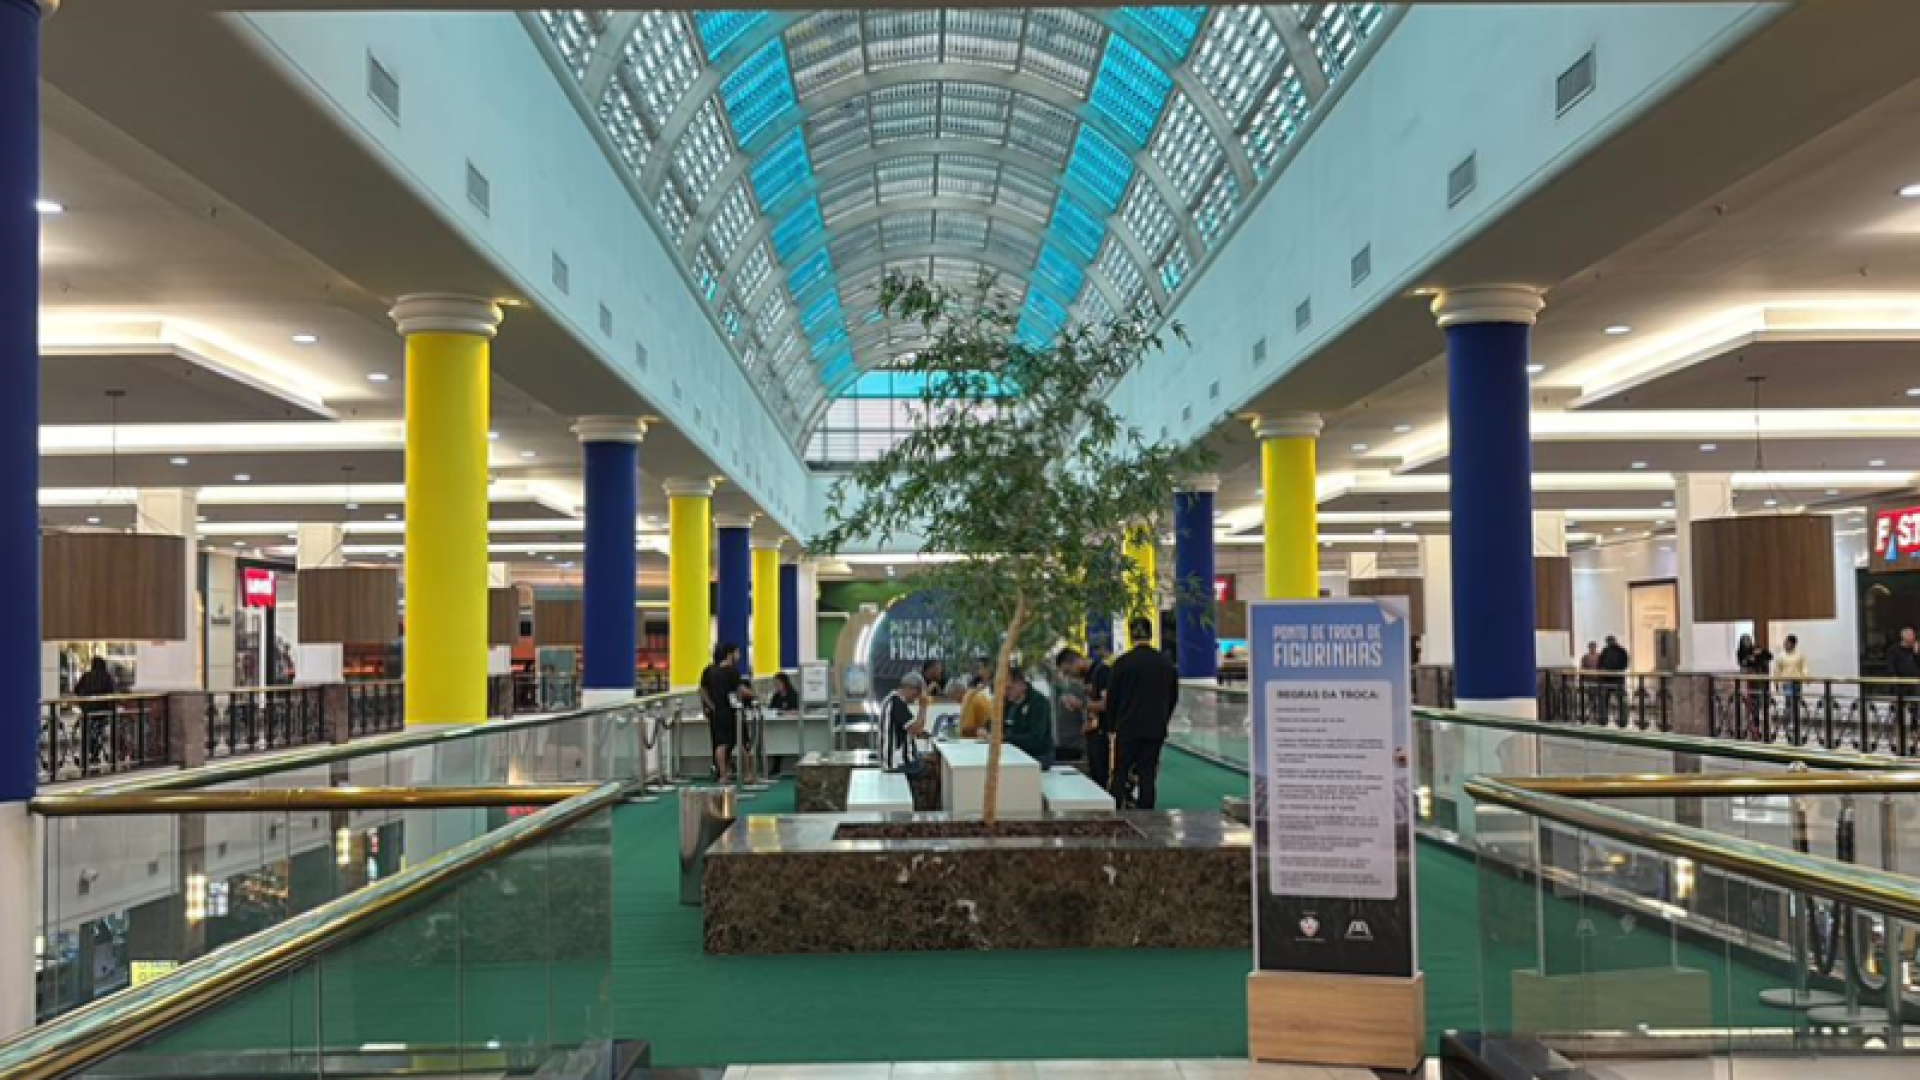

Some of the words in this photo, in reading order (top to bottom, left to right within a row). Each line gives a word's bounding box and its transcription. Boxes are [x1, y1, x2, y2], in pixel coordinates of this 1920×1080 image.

[1273, 642, 1383, 668] FIGURINHAS
[1277, 690, 1319, 699] REGRAS
[1322, 690, 1337, 699] DA
